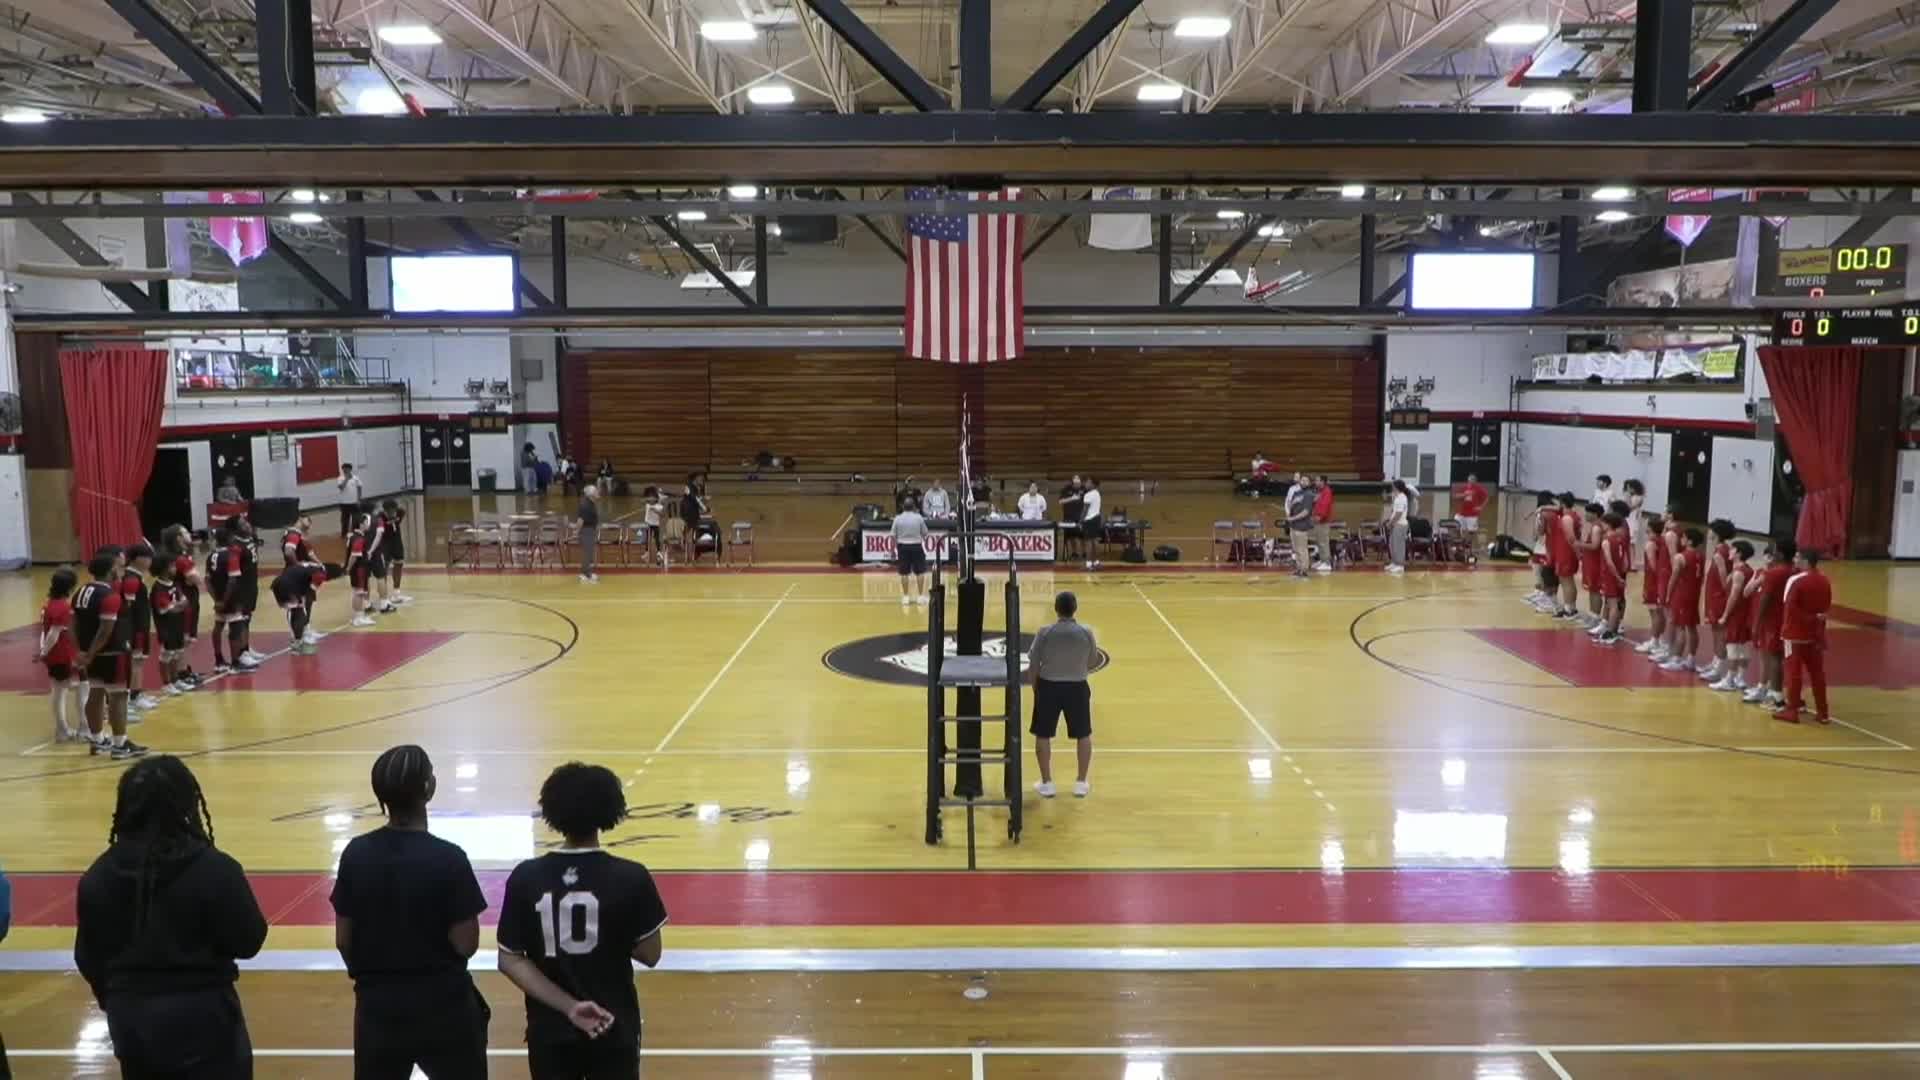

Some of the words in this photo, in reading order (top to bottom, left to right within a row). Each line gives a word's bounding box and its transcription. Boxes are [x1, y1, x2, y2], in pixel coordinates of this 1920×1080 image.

[1837, 247, 1891, 270] 00.0
[1785, 275, 1827, 286] BOXERS
[1783, 311, 1806, 319] FOULS
[1792, 319, 1803, 335] 0
[1817, 319, 1829, 336] 0
[1905, 316, 1919, 334] 0
[1851, 337, 1879, 345] MATCH
[988, 535, 1052, 552] BOXERS
[75, 585, 95, 609] 18
[535, 891, 599, 957] 10
